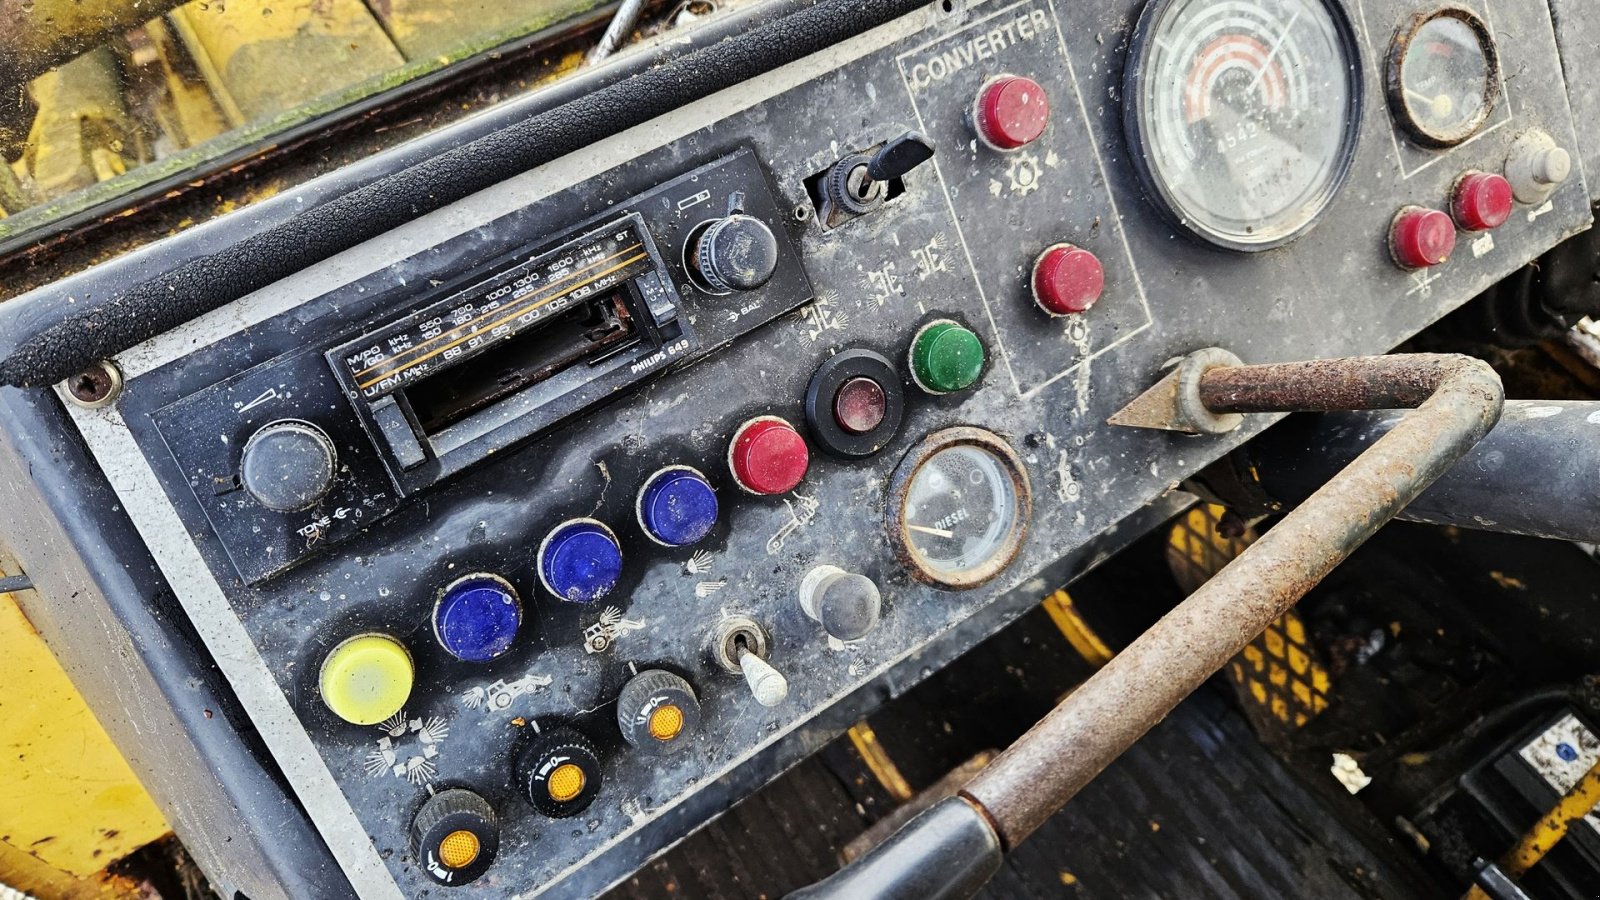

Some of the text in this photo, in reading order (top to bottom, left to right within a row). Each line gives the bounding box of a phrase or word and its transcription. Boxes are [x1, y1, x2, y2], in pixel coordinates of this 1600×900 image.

[912, 9, 1050, 88] CONVERTER
[615, 230, 629, 241] ST
[388, 334, 409, 347] kHz
[418, 317, 442, 332] 550
[450, 303, 473, 318] 700
[485, 285, 512, 301] 1000
[513, 272, 539, 288] 1300
[547, 257, 574, 272] 1600
[391, 341, 413, 354] kHz
[421, 327, 442, 340] 150
[452, 313, 472, 326] 180
[480, 300, 500, 314] 215
[511, 284, 534, 299] 255
[740, 302, 761, 316] BAL
[363, 275, 617, 397] U/FM MHz 88 91 95 100 105 108 MHz
[631, 339, 690, 374] PHILIPS 649
[296, 515, 332, 537] TONE
[934, 508, 971, 531] DIESEL
